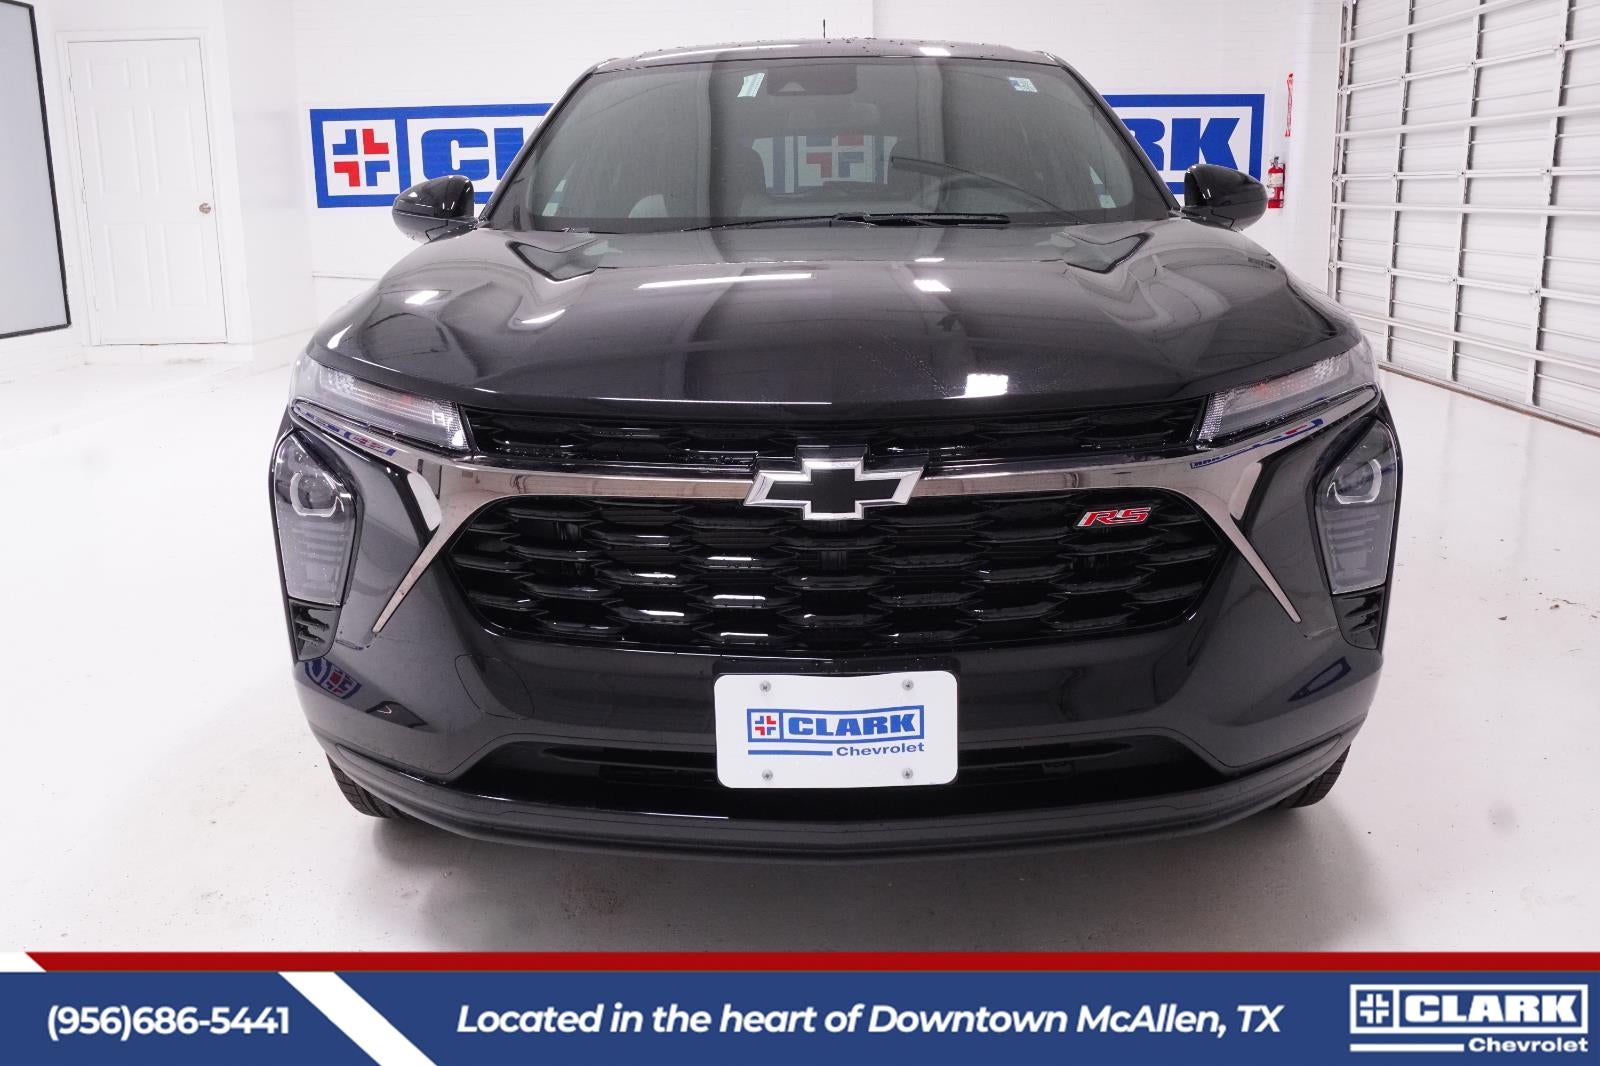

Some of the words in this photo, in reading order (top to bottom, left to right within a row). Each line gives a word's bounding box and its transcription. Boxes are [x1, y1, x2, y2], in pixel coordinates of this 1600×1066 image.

[1077, 506, 1152, 527] RS
[788, 713, 916, 736] CLARK
[835, 742, 925, 757] Chevrolet
